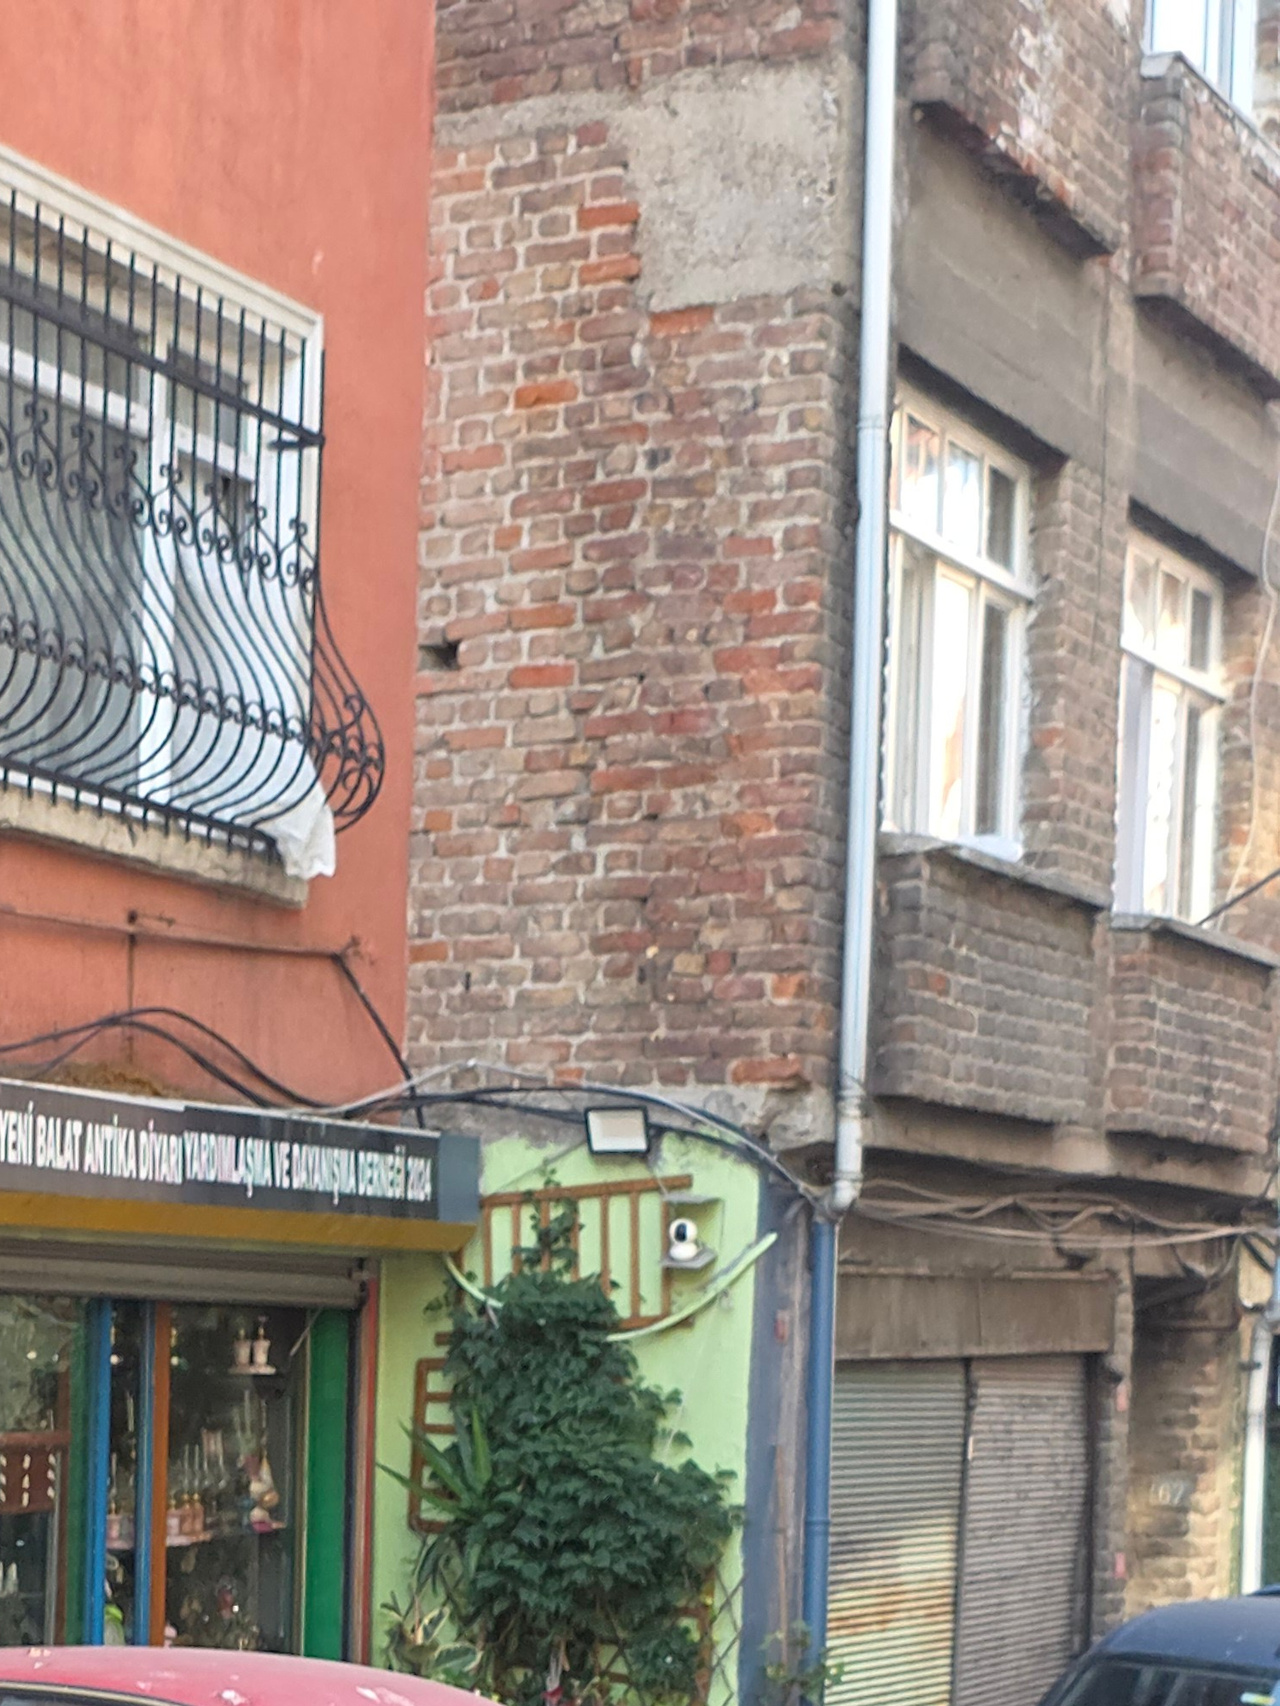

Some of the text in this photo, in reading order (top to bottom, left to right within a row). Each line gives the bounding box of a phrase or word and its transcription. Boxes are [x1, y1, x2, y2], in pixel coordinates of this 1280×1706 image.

[35, 1114, 82, 1171] BALAT
[83, 1113, 137, 1179] ANTİKA
[138, 1118, 183, 1184] DİYARI
[183, 1130, 272, 1198] YARDIMLAŞMA
[273, 1140, 291, 1189] VE
[292, 1142, 356, 1207] DAYANIŞMA
[357, 1144, 406, 1199] DERNEĞİ
